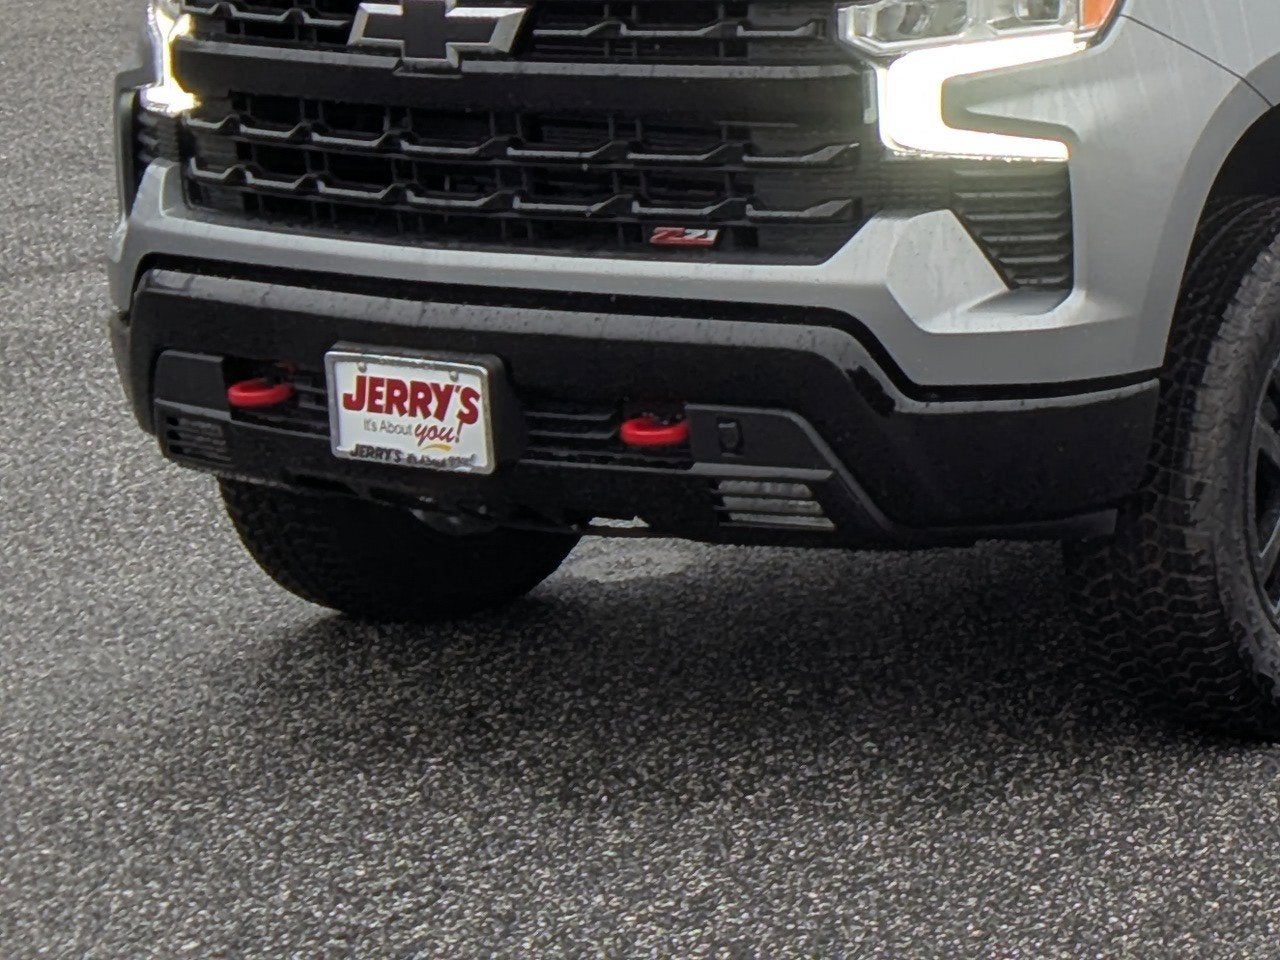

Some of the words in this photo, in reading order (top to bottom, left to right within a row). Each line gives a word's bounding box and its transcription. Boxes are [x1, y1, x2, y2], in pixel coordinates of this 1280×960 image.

[342, 375, 481, 425] JERRY'S
[379, 419, 412, 436] About
[414, 421, 464, 446] you!
